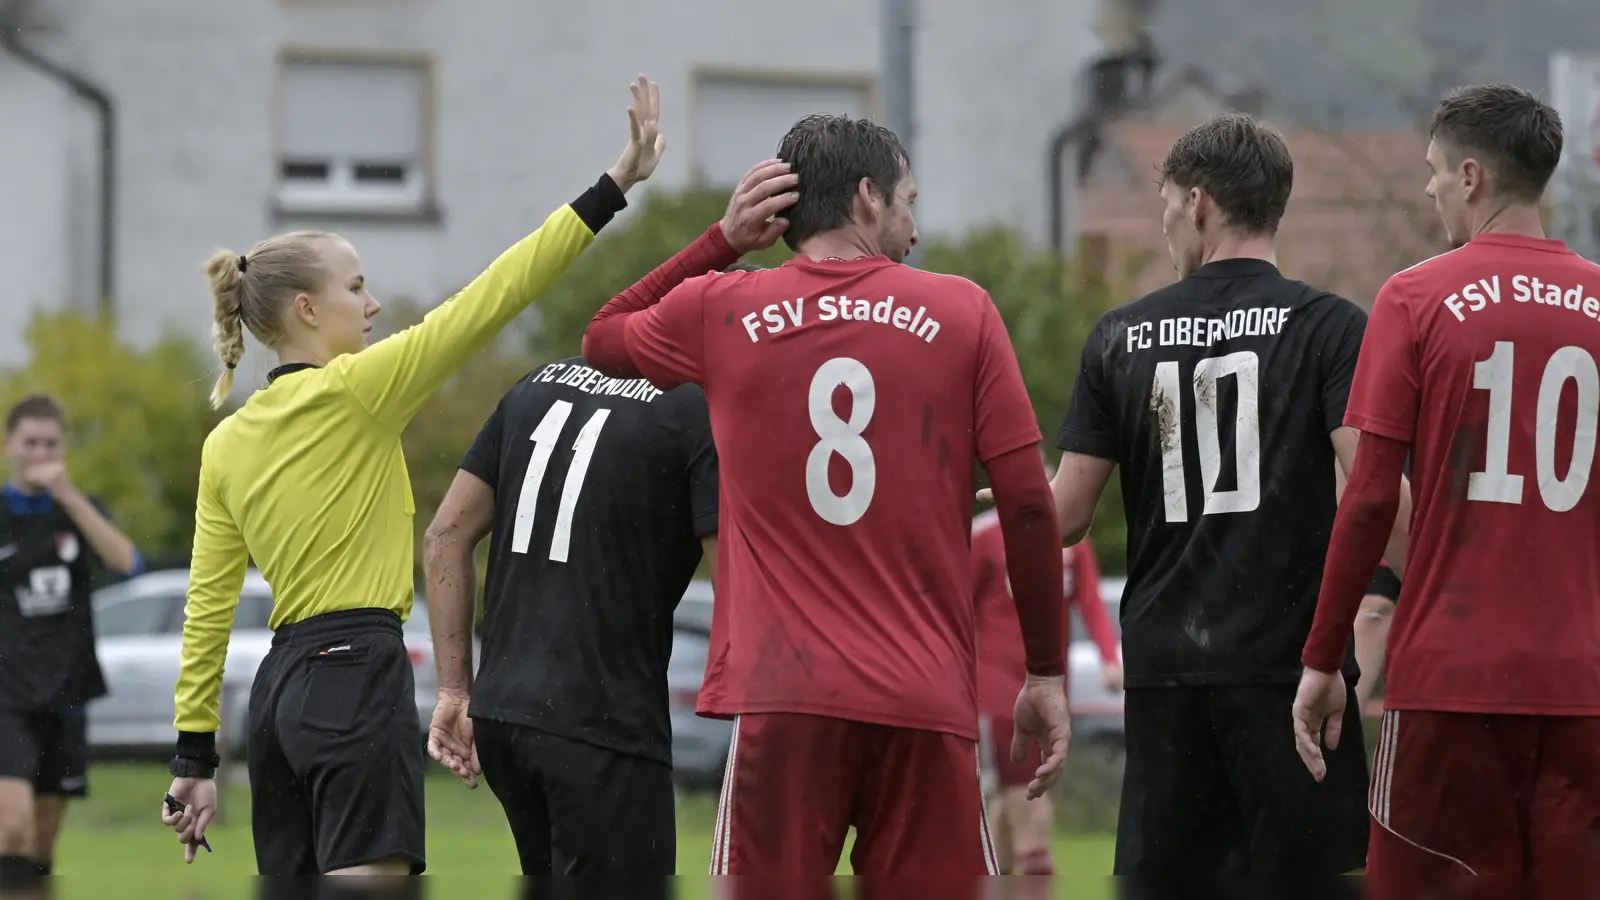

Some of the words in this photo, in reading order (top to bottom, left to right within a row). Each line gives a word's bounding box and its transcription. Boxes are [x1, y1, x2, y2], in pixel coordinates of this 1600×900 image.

[741, 297, 804, 343] FSV
[817, 295, 941, 343] Stadeln
[1126, 323, 1153, 353] FC
[1159, 307, 1293, 347] OBERNDORF
[1443, 275, 1502, 322] FSV
[1512, 274, 1600, 324] Stade
[531, 363, 567, 383] FC
[1468, 341, 1600, 512] 10
[511, 399, 612, 563] 11
[805, 357, 876, 526] 8
[1150, 350, 1261, 523] 10
